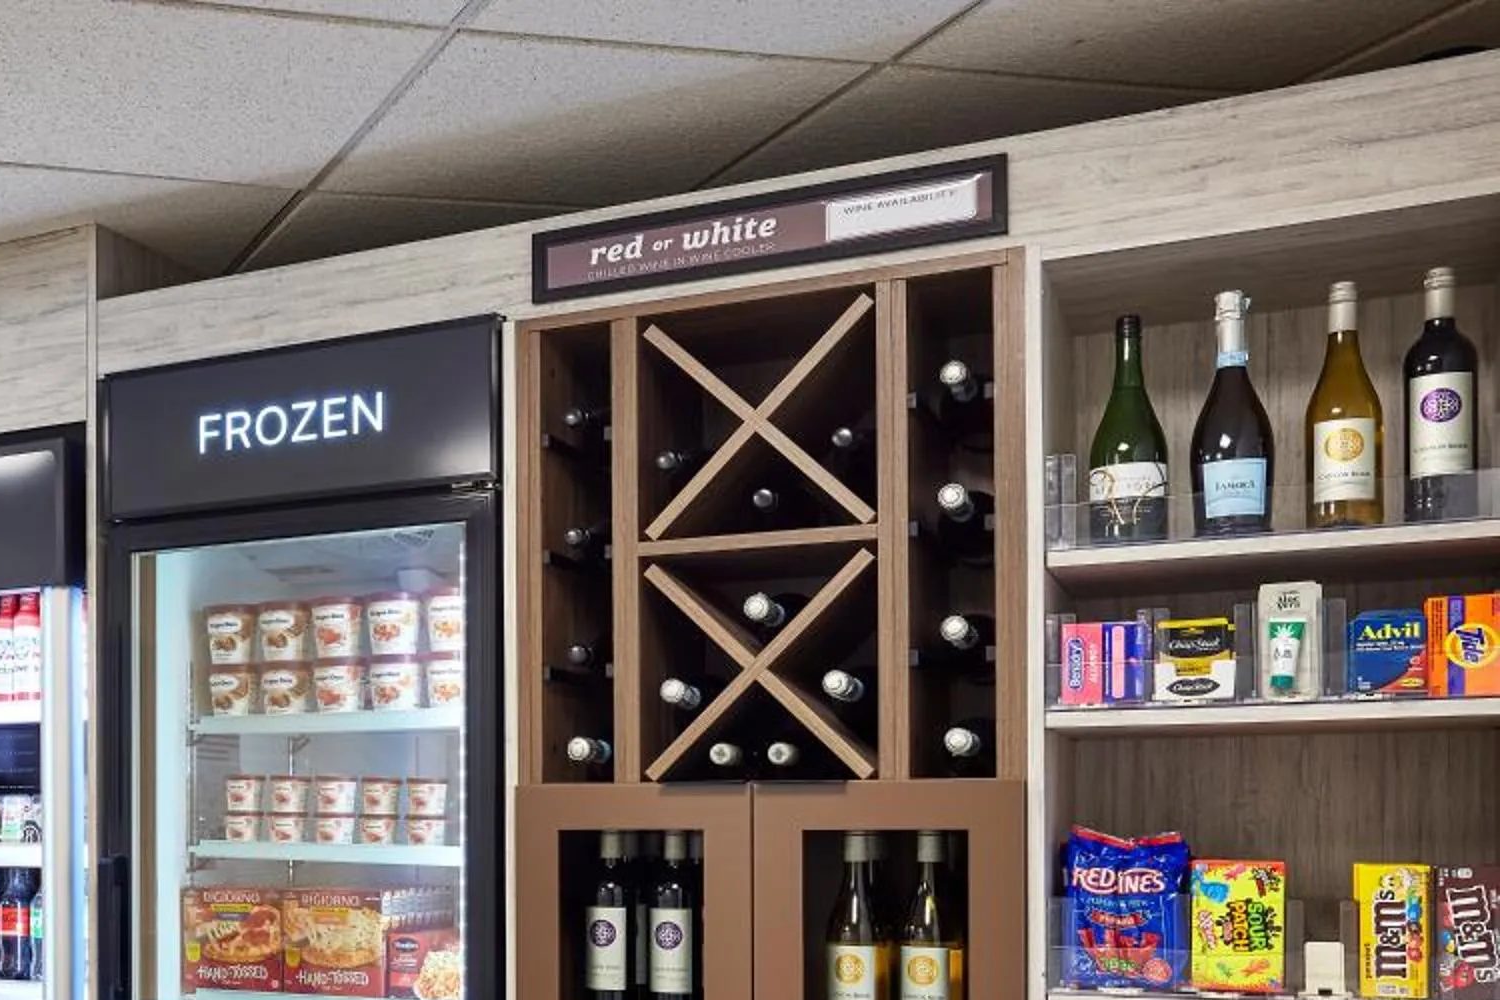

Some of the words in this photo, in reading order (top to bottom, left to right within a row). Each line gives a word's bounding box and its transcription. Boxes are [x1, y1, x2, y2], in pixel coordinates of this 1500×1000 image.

[844, 202, 873, 215] WINE
[590, 233, 644, 266] red
[652, 238, 673, 252] or
[682, 217, 778, 250] white
[588, 265, 637, 281] CHILLED
[640, 261, 669, 272] WINE
[673, 257, 684, 266] IN
[689, 252, 718, 264] WINE
[723, 242, 776, 258] COOLER
[198, 391, 384, 454] FROZEN
[1357, 621, 1421, 640] Advil
[1455, 628, 1484, 663] Tide
[1072, 867, 1116, 893] RED
[1229, 898, 1249, 953] PATCH
[1250, 902, 1266, 951] SOUR
